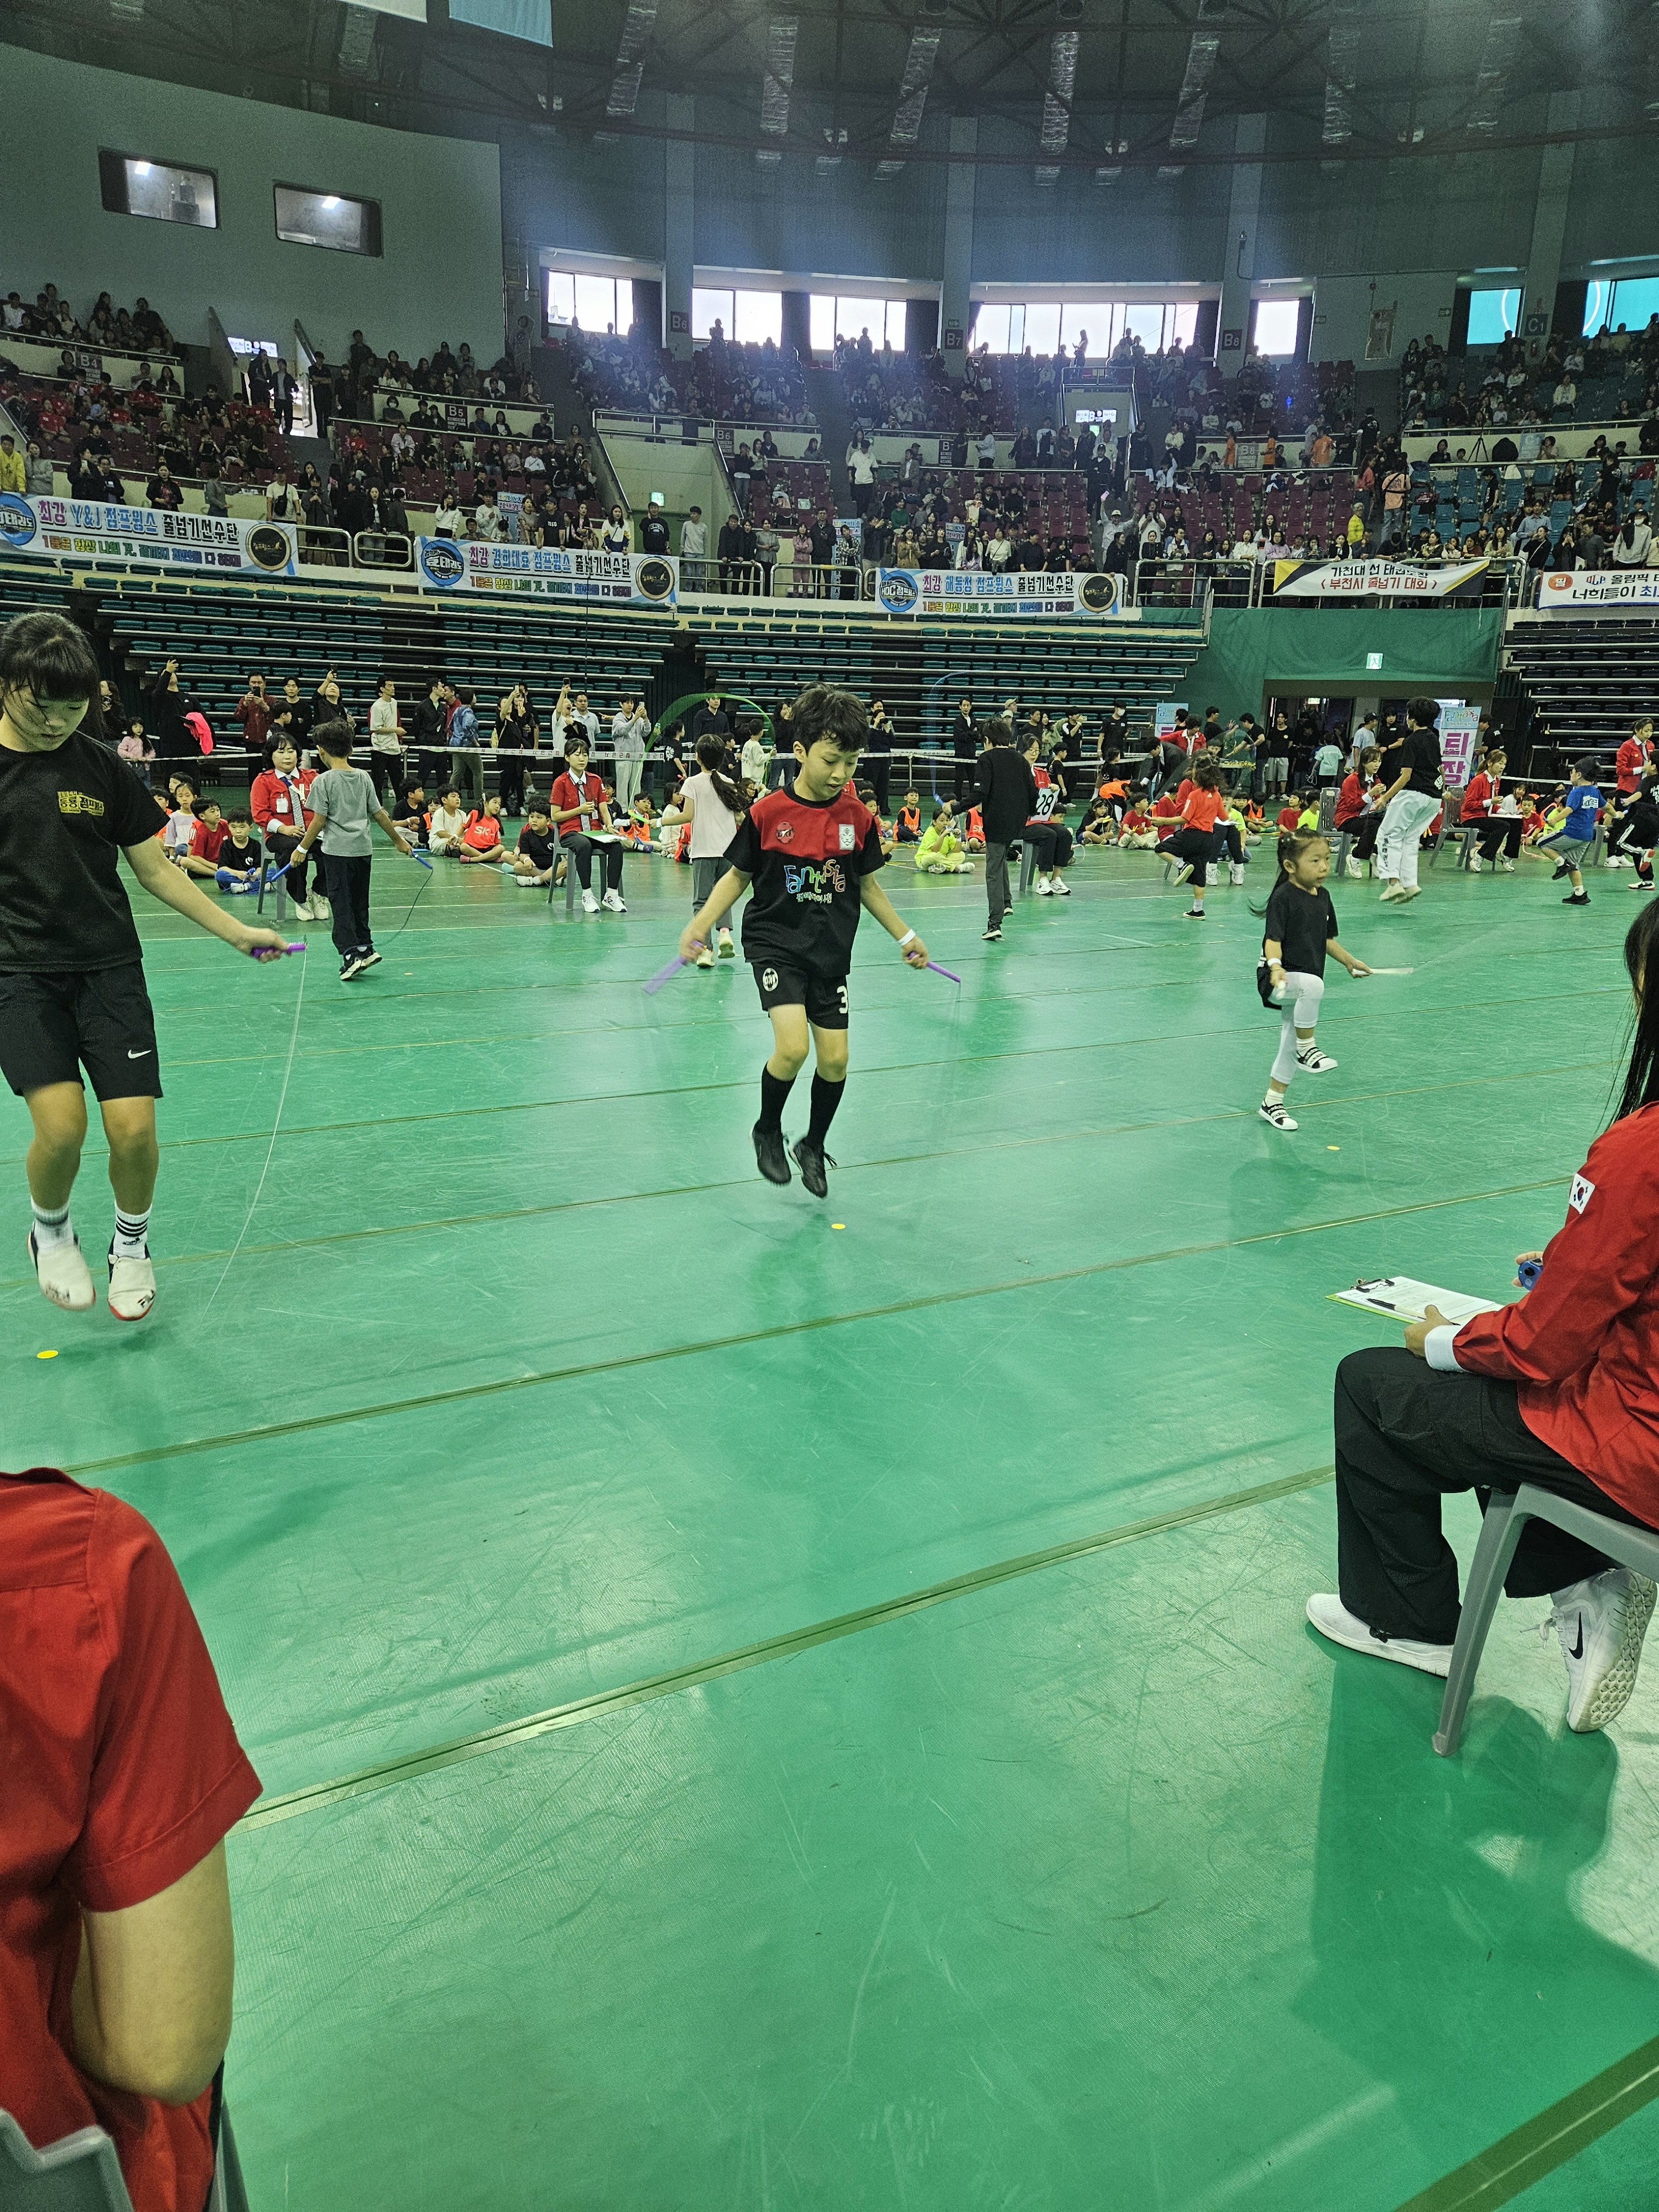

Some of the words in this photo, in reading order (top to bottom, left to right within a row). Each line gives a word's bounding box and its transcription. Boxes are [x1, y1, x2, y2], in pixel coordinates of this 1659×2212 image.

[672, 316, 687, 328] B6
[1528, 318, 1543, 332] C1
[947, 333, 961, 346] B7
[1224, 333, 1239, 346] B8
[80, 354, 97, 368] B4
[449, 405, 463, 417] B5
[717, 430, 730, 440] B6
[1240, 446, 1254, 455] B8
[39, 500, 66, 525] 최강
[71, 504, 101, 528] Y&J
[106, 508, 158, 534] 점프윙스
[163, 514, 239, 544] 줄넘기선수단
[42, 535, 71, 551] 1등은
[74, 538, 96, 552] 항상
[98, 541, 121, 555] 나의
[205, 552, 216, 565] 다
[469, 546, 488, 567] 최강
[534, 551, 572, 572] 점프윙스
[576, 555, 631, 577] 줄넘기선수단
[1331, 565, 1365, 577] 가천대
[1369, 564, 1380, 576] 선
[1384, 564, 1429, 578] 태권도장
[470, 576, 493, 588] 1등은
[495, 578, 513, 590] 항상
[514, 580, 531, 592] 나의
[602, 585, 611, 596] 다
[922, 575, 942, 594] 최강
[946, 575, 973, 594] 해동청
[977, 576, 1014, 594] 점프윙스
[1017, 575, 1074, 594] 줄넘기선수단
[1329, 577, 1364, 589] 부천시
[1368, 577, 1401, 589] 줄넘기
[1404, 577, 1428, 589] 대회
[1611, 573, 1649, 585] 올림픽
[1572, 586, 1636, 600] 너희들이
[1639, 585, 1659, 597] 최
[922, 601, 943, 612] 1등은
[946, 602, 961, 613] 항상
[963, 603, 979, 613] 나의
[1045, 602, 1053, 612] 다
[1442, 732, 1470, 785] 퇴장
[1036, 794, 1054, 816] 28
[474, 826, 491, 836] SK
[837, 985, 848, 1014] 3
